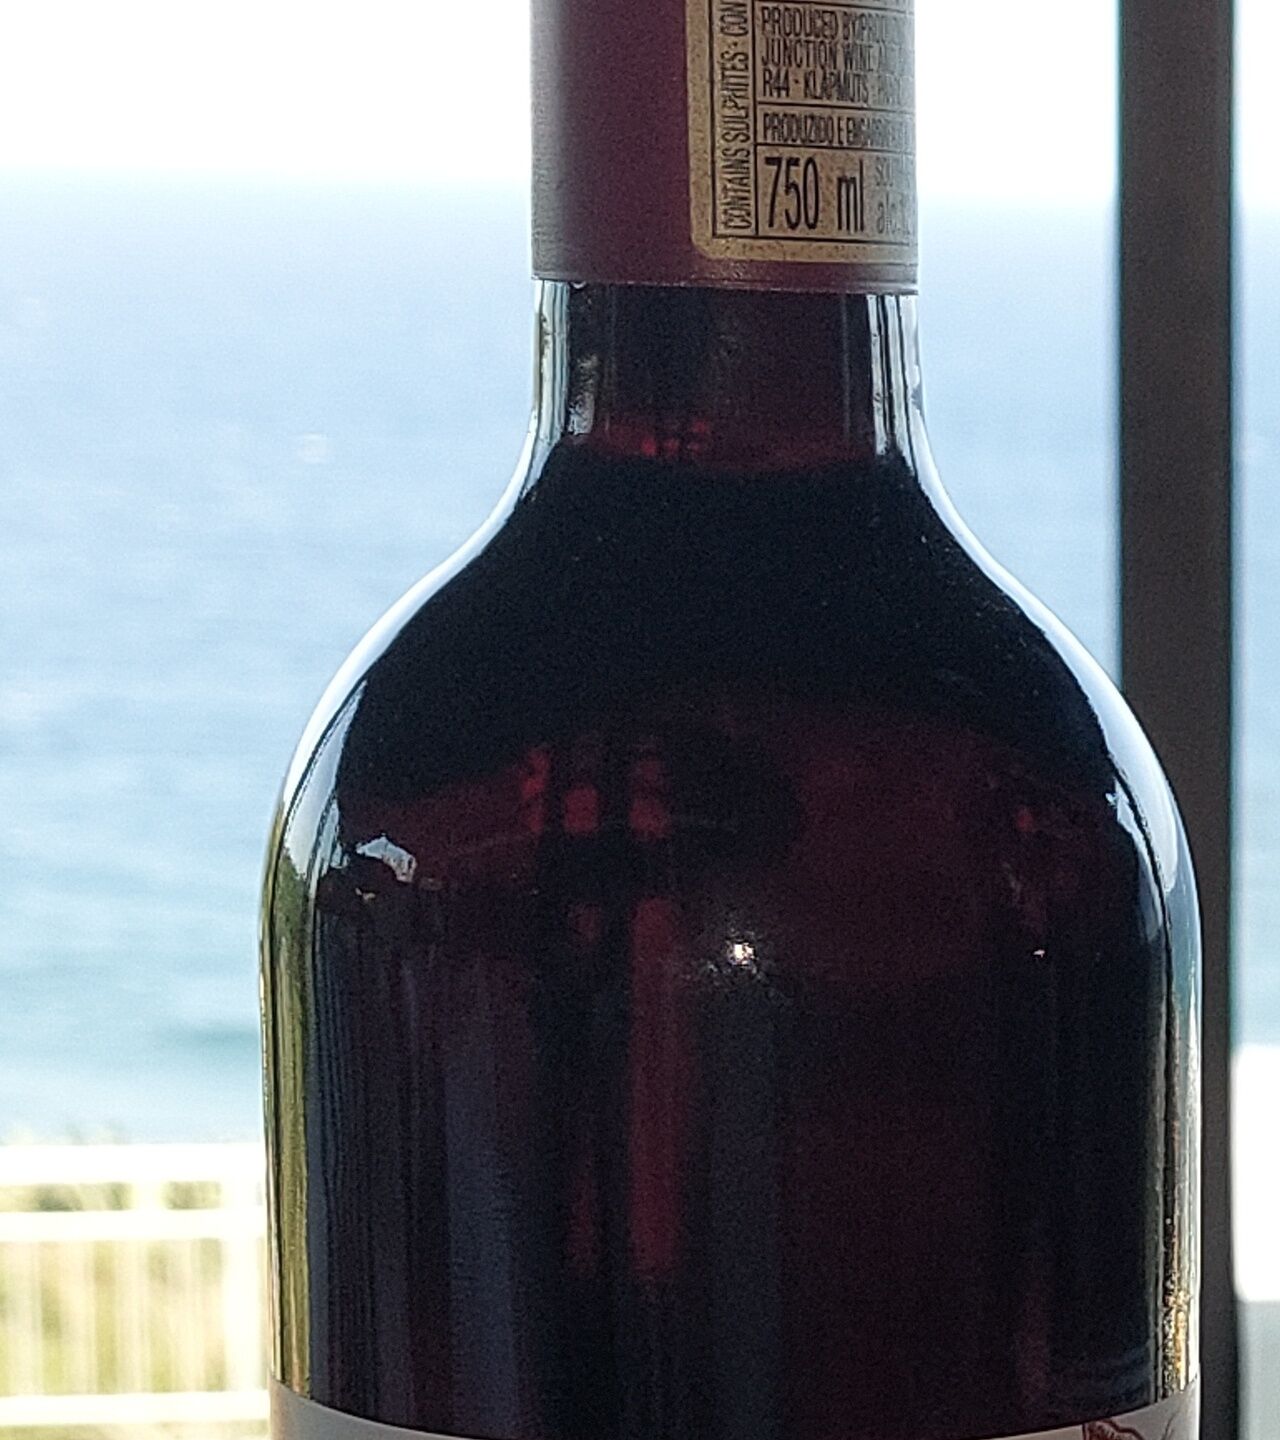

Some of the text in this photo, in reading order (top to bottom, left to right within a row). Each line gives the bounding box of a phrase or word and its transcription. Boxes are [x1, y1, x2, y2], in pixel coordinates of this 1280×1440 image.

[719, 51, 751, 143] SULPHITES
[722, 147, 752, 230] CONTAINS
[764, 156, 820, 230] 750
[836, 158, 865, 232] ml
